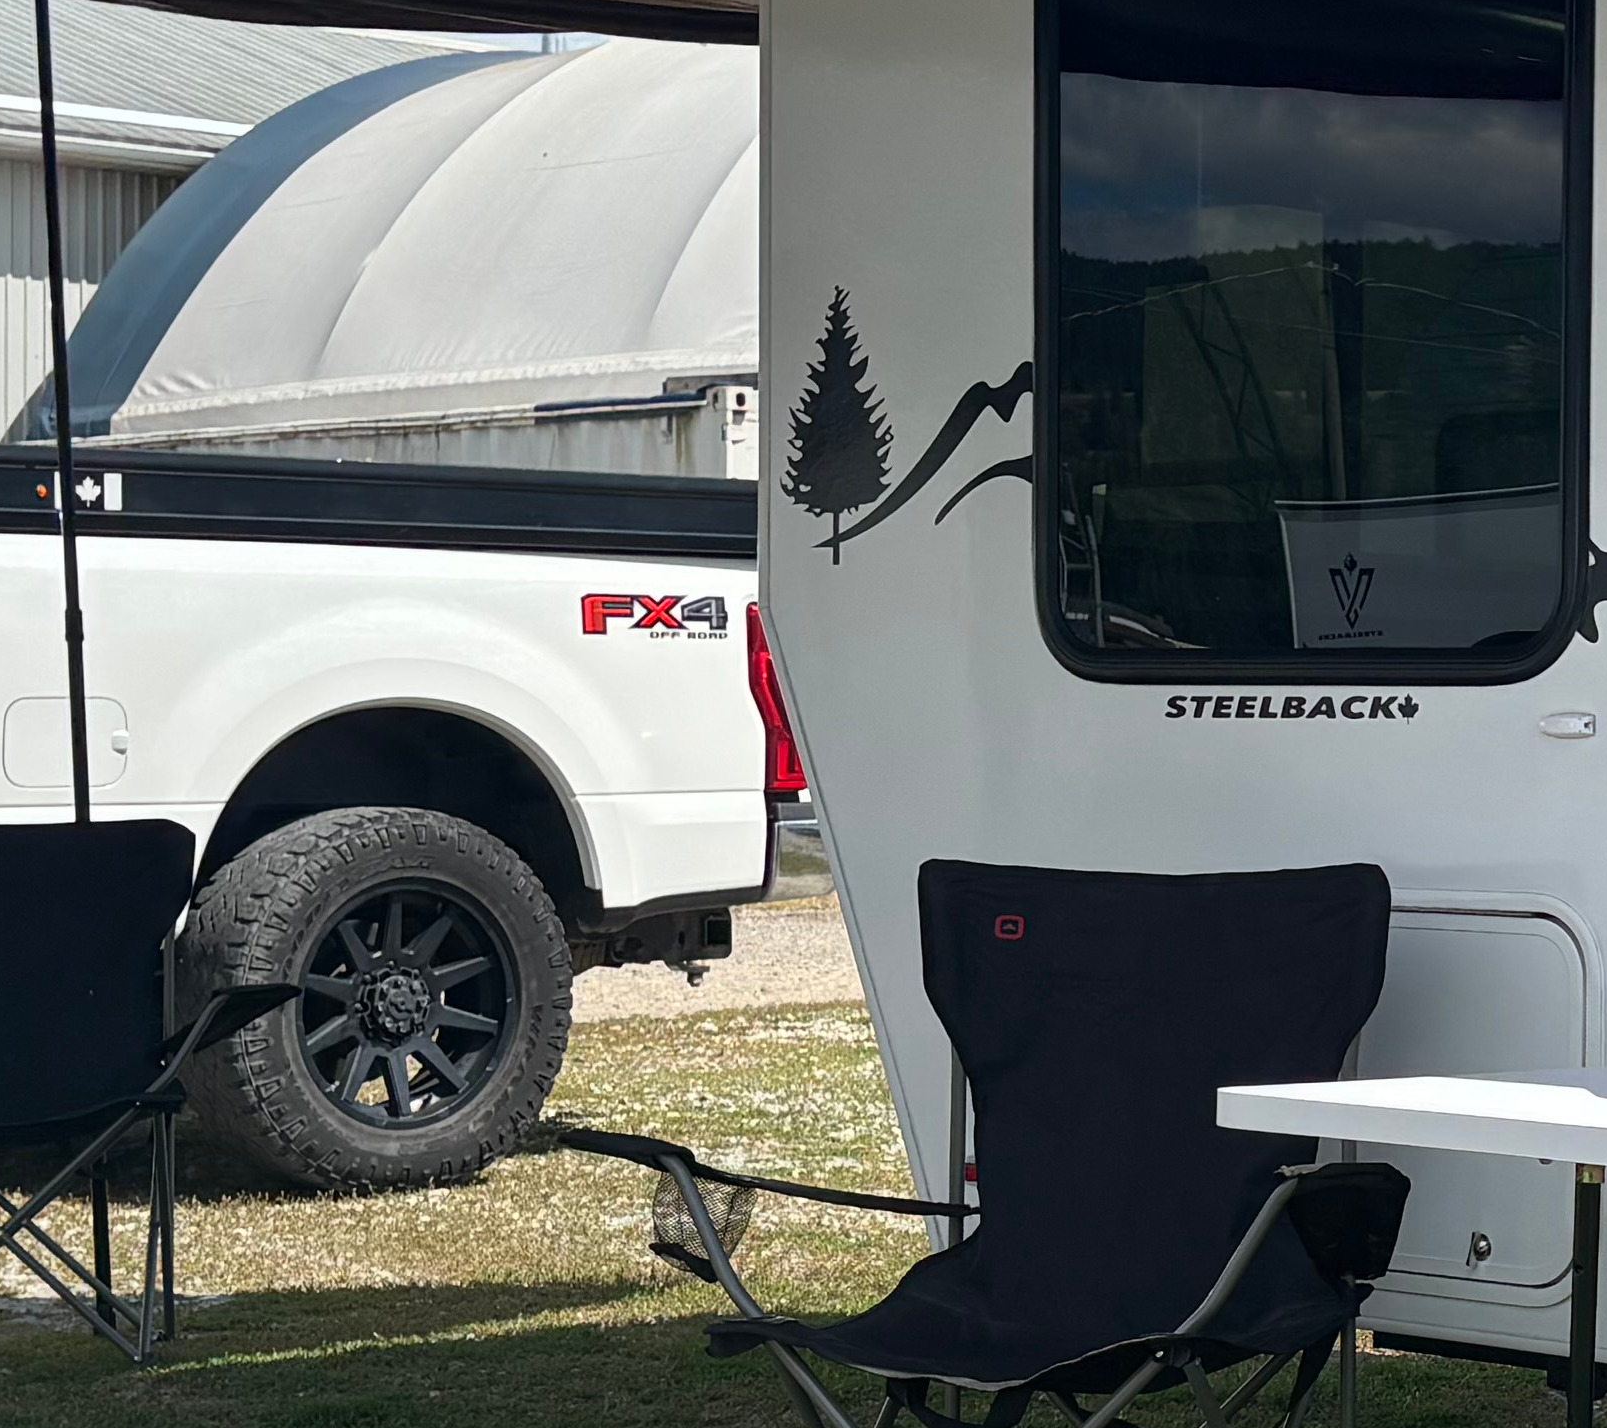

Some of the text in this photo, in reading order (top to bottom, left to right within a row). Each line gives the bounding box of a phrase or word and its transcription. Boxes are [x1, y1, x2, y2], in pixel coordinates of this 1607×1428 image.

[580, 593, 728, 635] FX4
[649, 631, 728, 640] OFF ROAD
[1164, 695, 1399, 719] STEELBACK
